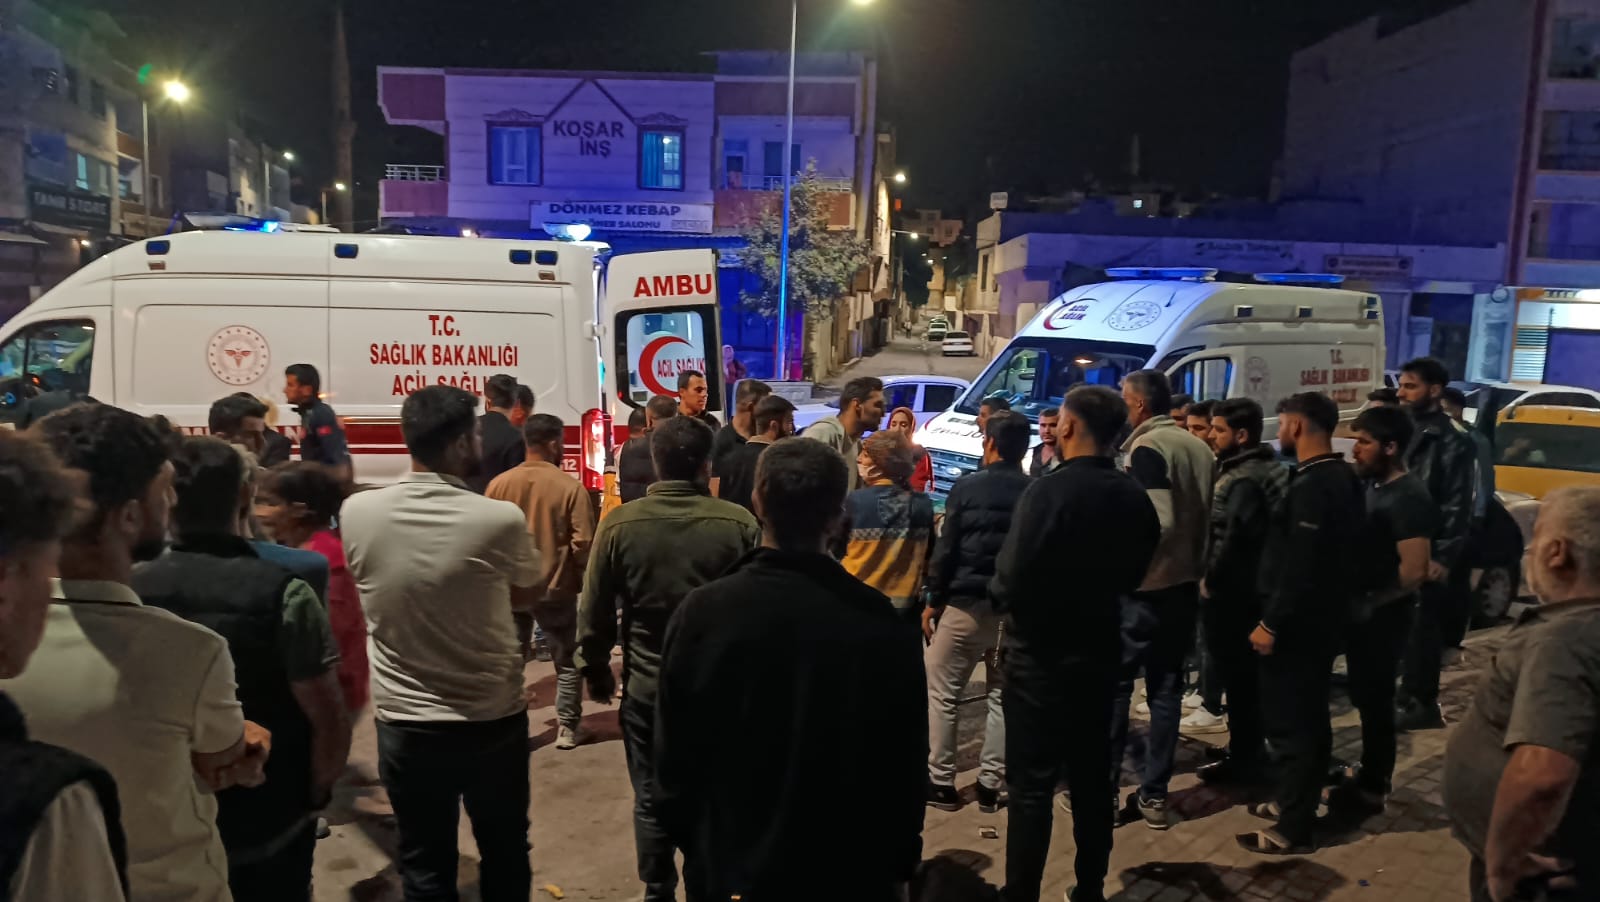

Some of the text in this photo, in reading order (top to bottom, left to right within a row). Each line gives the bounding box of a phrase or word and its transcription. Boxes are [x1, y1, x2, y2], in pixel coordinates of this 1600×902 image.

[553, 120, 624, 138] KOŞAR
[580, 136, 611, 157] İNŞ
[550, 200, 681, 216] DÖNMEZ KEBAP
[618, 220, 661, 229] SALONU
[634, 274, 712, 297] AMBU
[428, 315, 460, 336] T.C.
[370, 341, 518, 367] SAĞLIK BAKANLIĞI
[437, 370, 489, 396] SAĞL
[560, 458, 577, 471] 12
